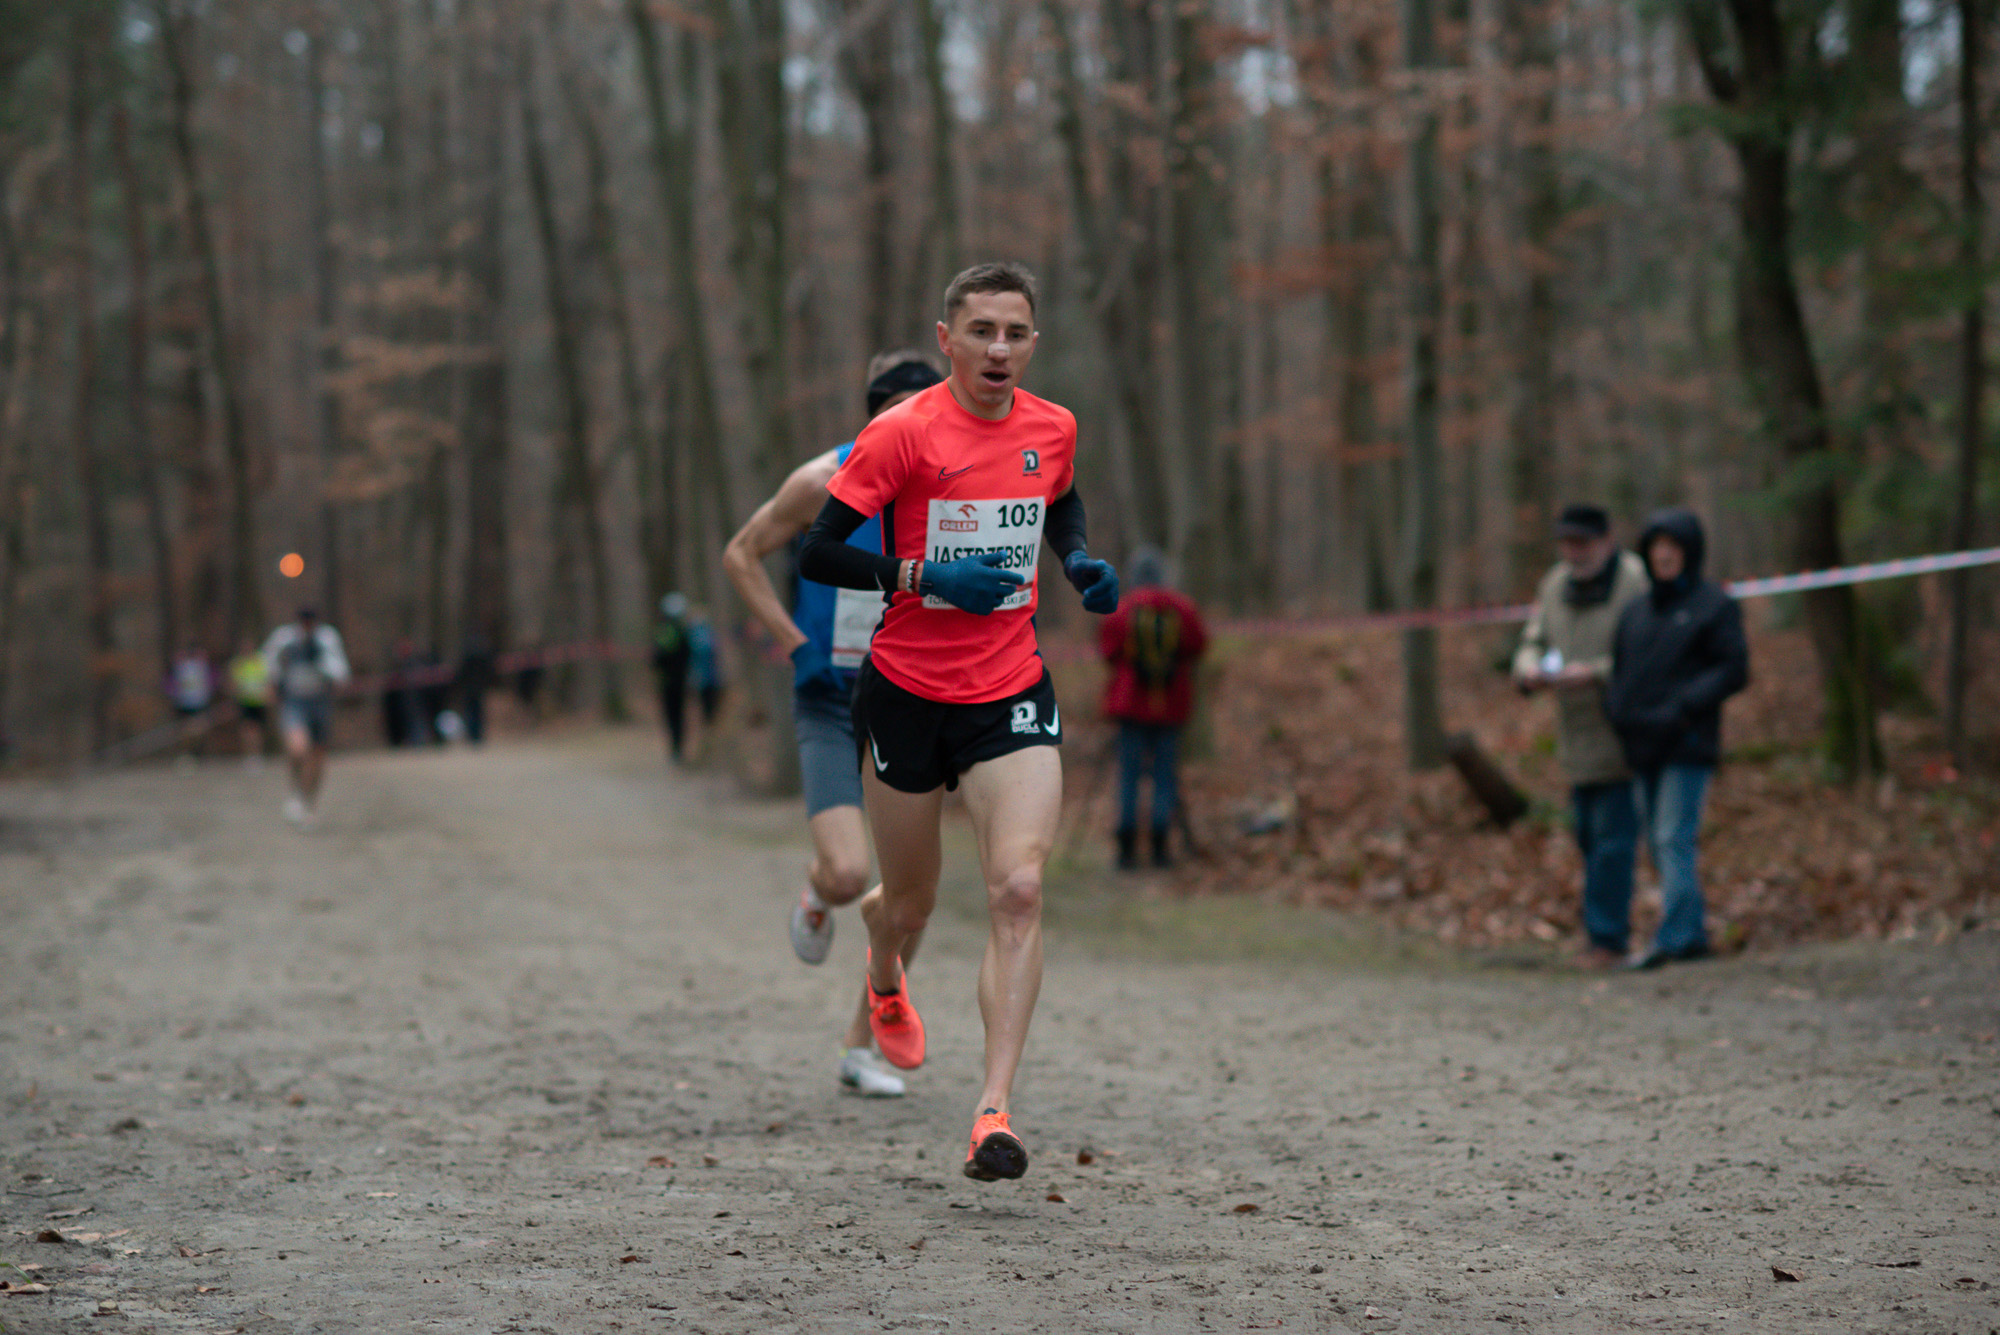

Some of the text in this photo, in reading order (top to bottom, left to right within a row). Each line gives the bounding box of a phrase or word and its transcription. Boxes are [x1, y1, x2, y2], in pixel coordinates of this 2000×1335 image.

[940, 521, 978, 531] ORLEN
[998, 503, 1039, 528] 103
[934, 543, 1035, 569] JASBSKI
